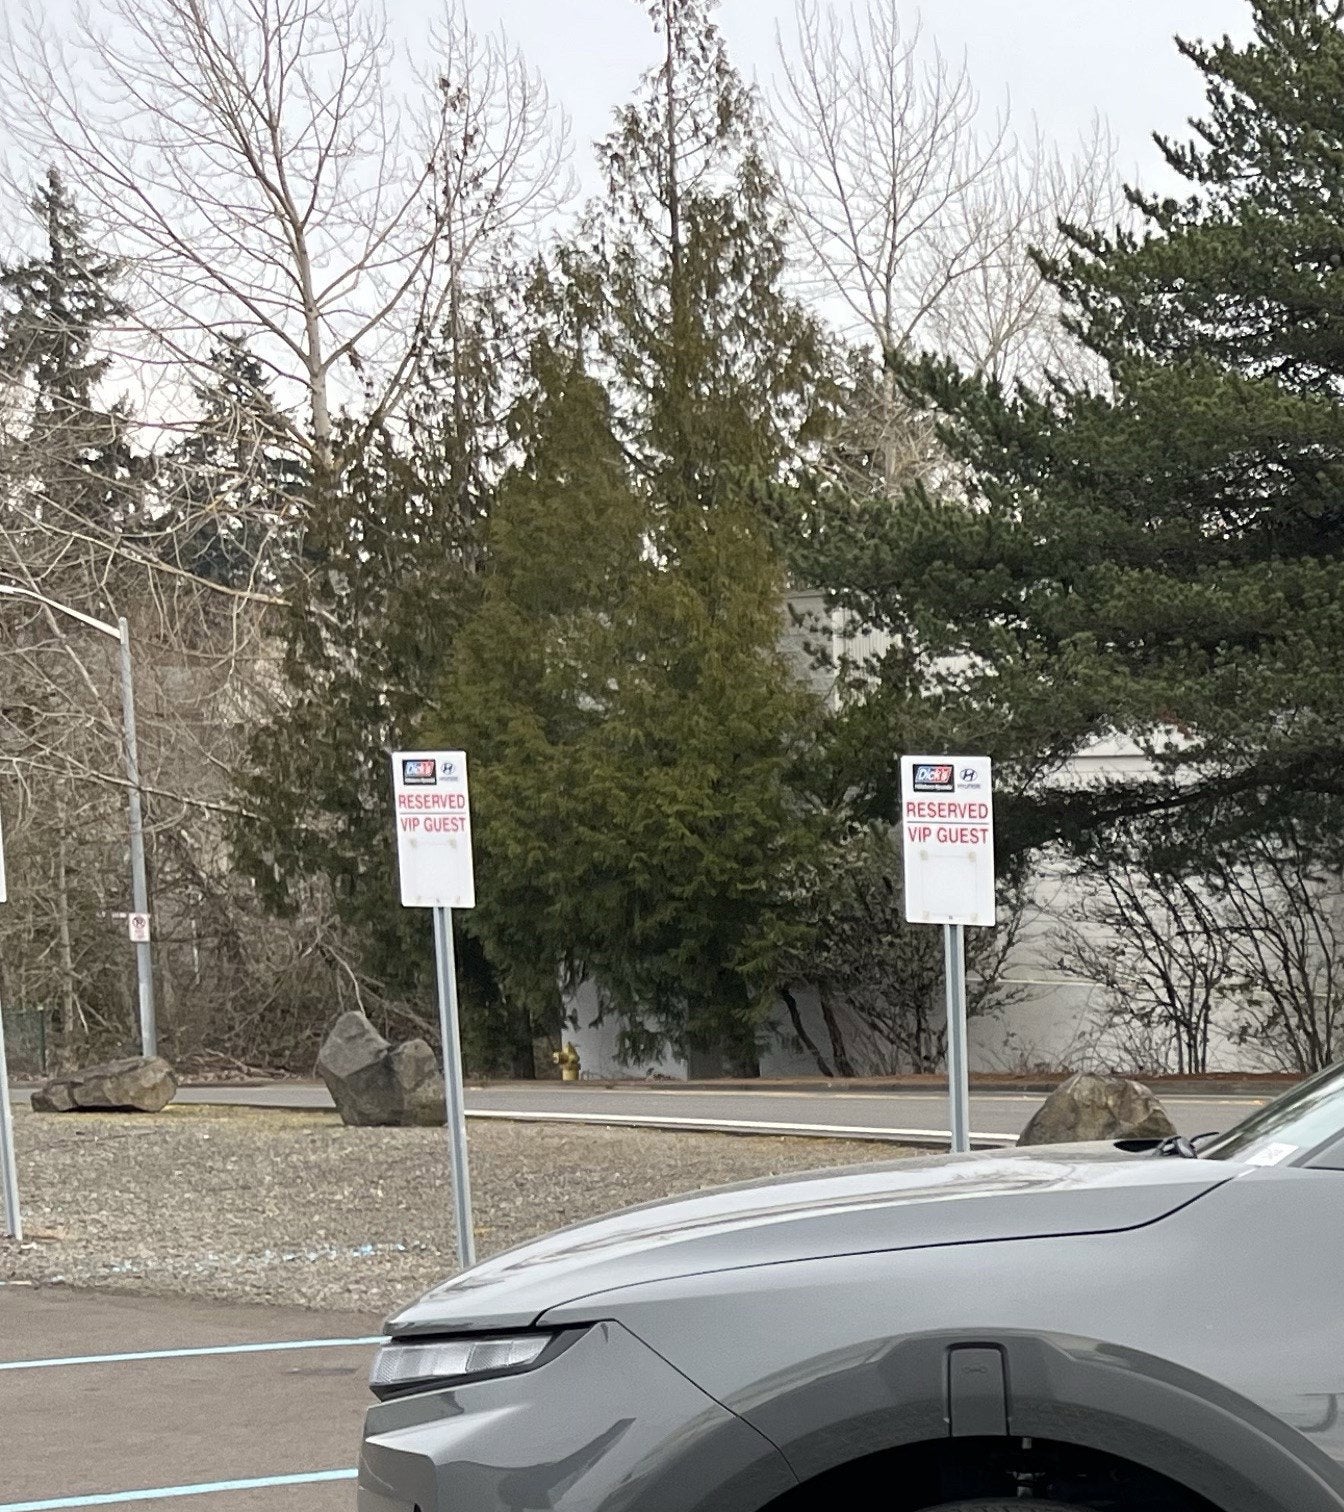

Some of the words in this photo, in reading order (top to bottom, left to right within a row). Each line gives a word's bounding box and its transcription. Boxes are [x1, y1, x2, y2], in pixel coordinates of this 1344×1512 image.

[398, 794, 465, 810] RESERVED
[906, 801, 989, 819] RESERVED
[400, 817, 420, 832] VIP
[423, 817, 466, 833] GUEST
[908, 827, 932, 843] VIP
[937, 827, 989, 844] GUEST
